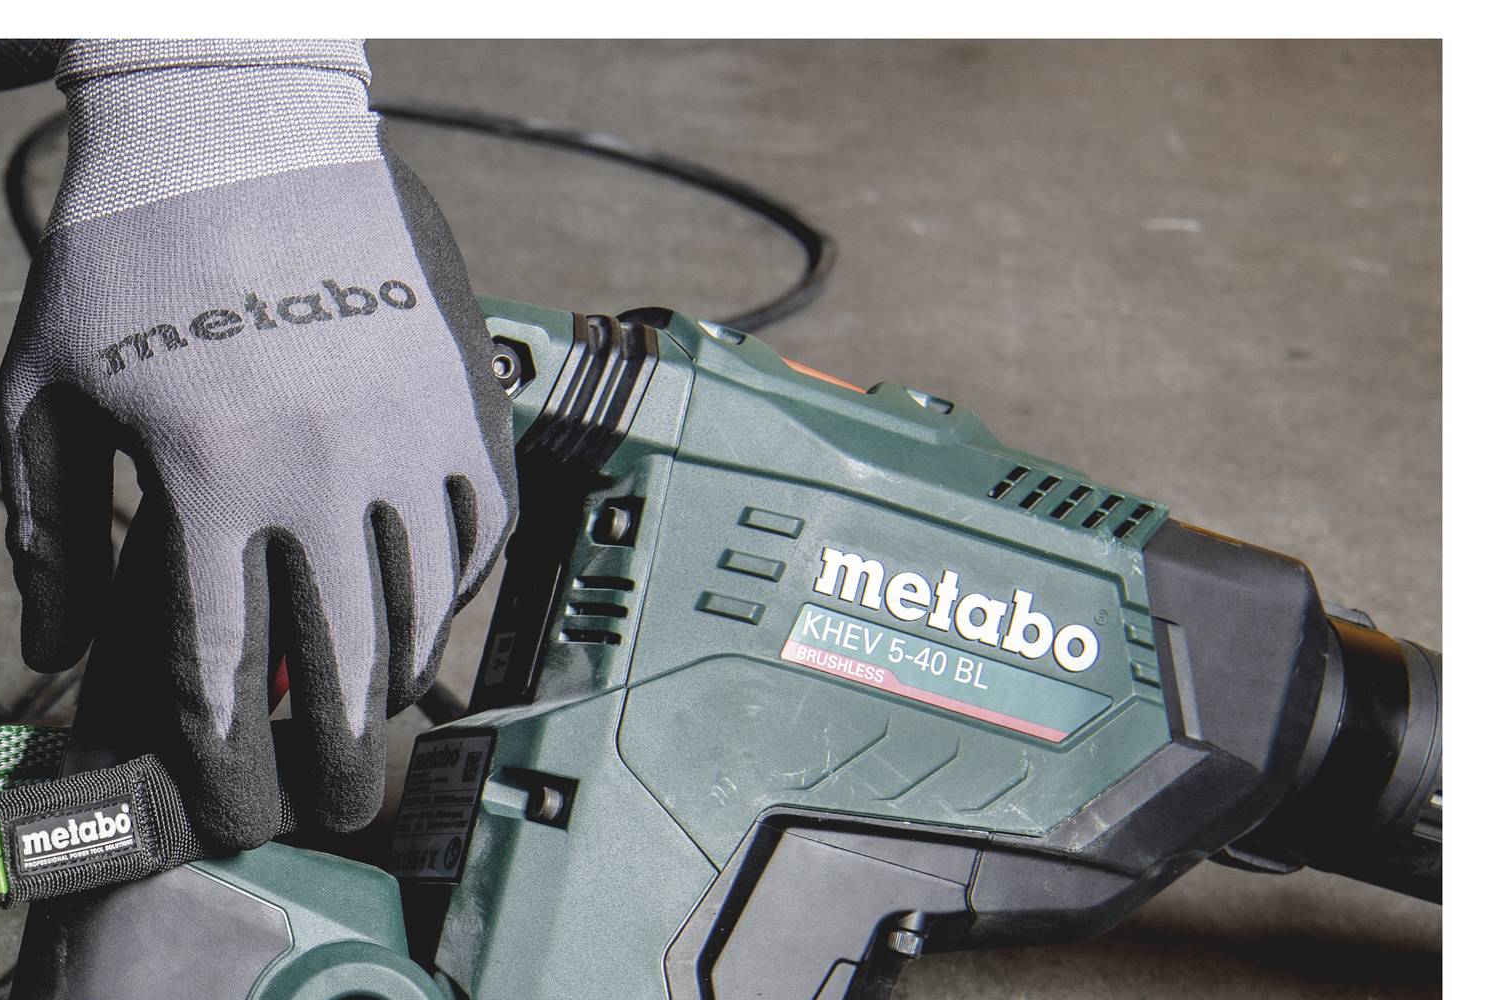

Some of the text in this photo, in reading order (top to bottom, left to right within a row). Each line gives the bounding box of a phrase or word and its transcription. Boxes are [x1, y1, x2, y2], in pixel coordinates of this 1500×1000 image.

[98, 279, 418, 377] metabo
[813, 547, 1099, 673] metabo
[796, 646, 886, 683] BRUSHLESS
[802, 610, 989, 690] KHEV 5-40 BL
[22, 811, 132, 856] metabo
[24, 854, 69, 869] PROFESSIONAL
[69, 849, 90, 860] POWER
